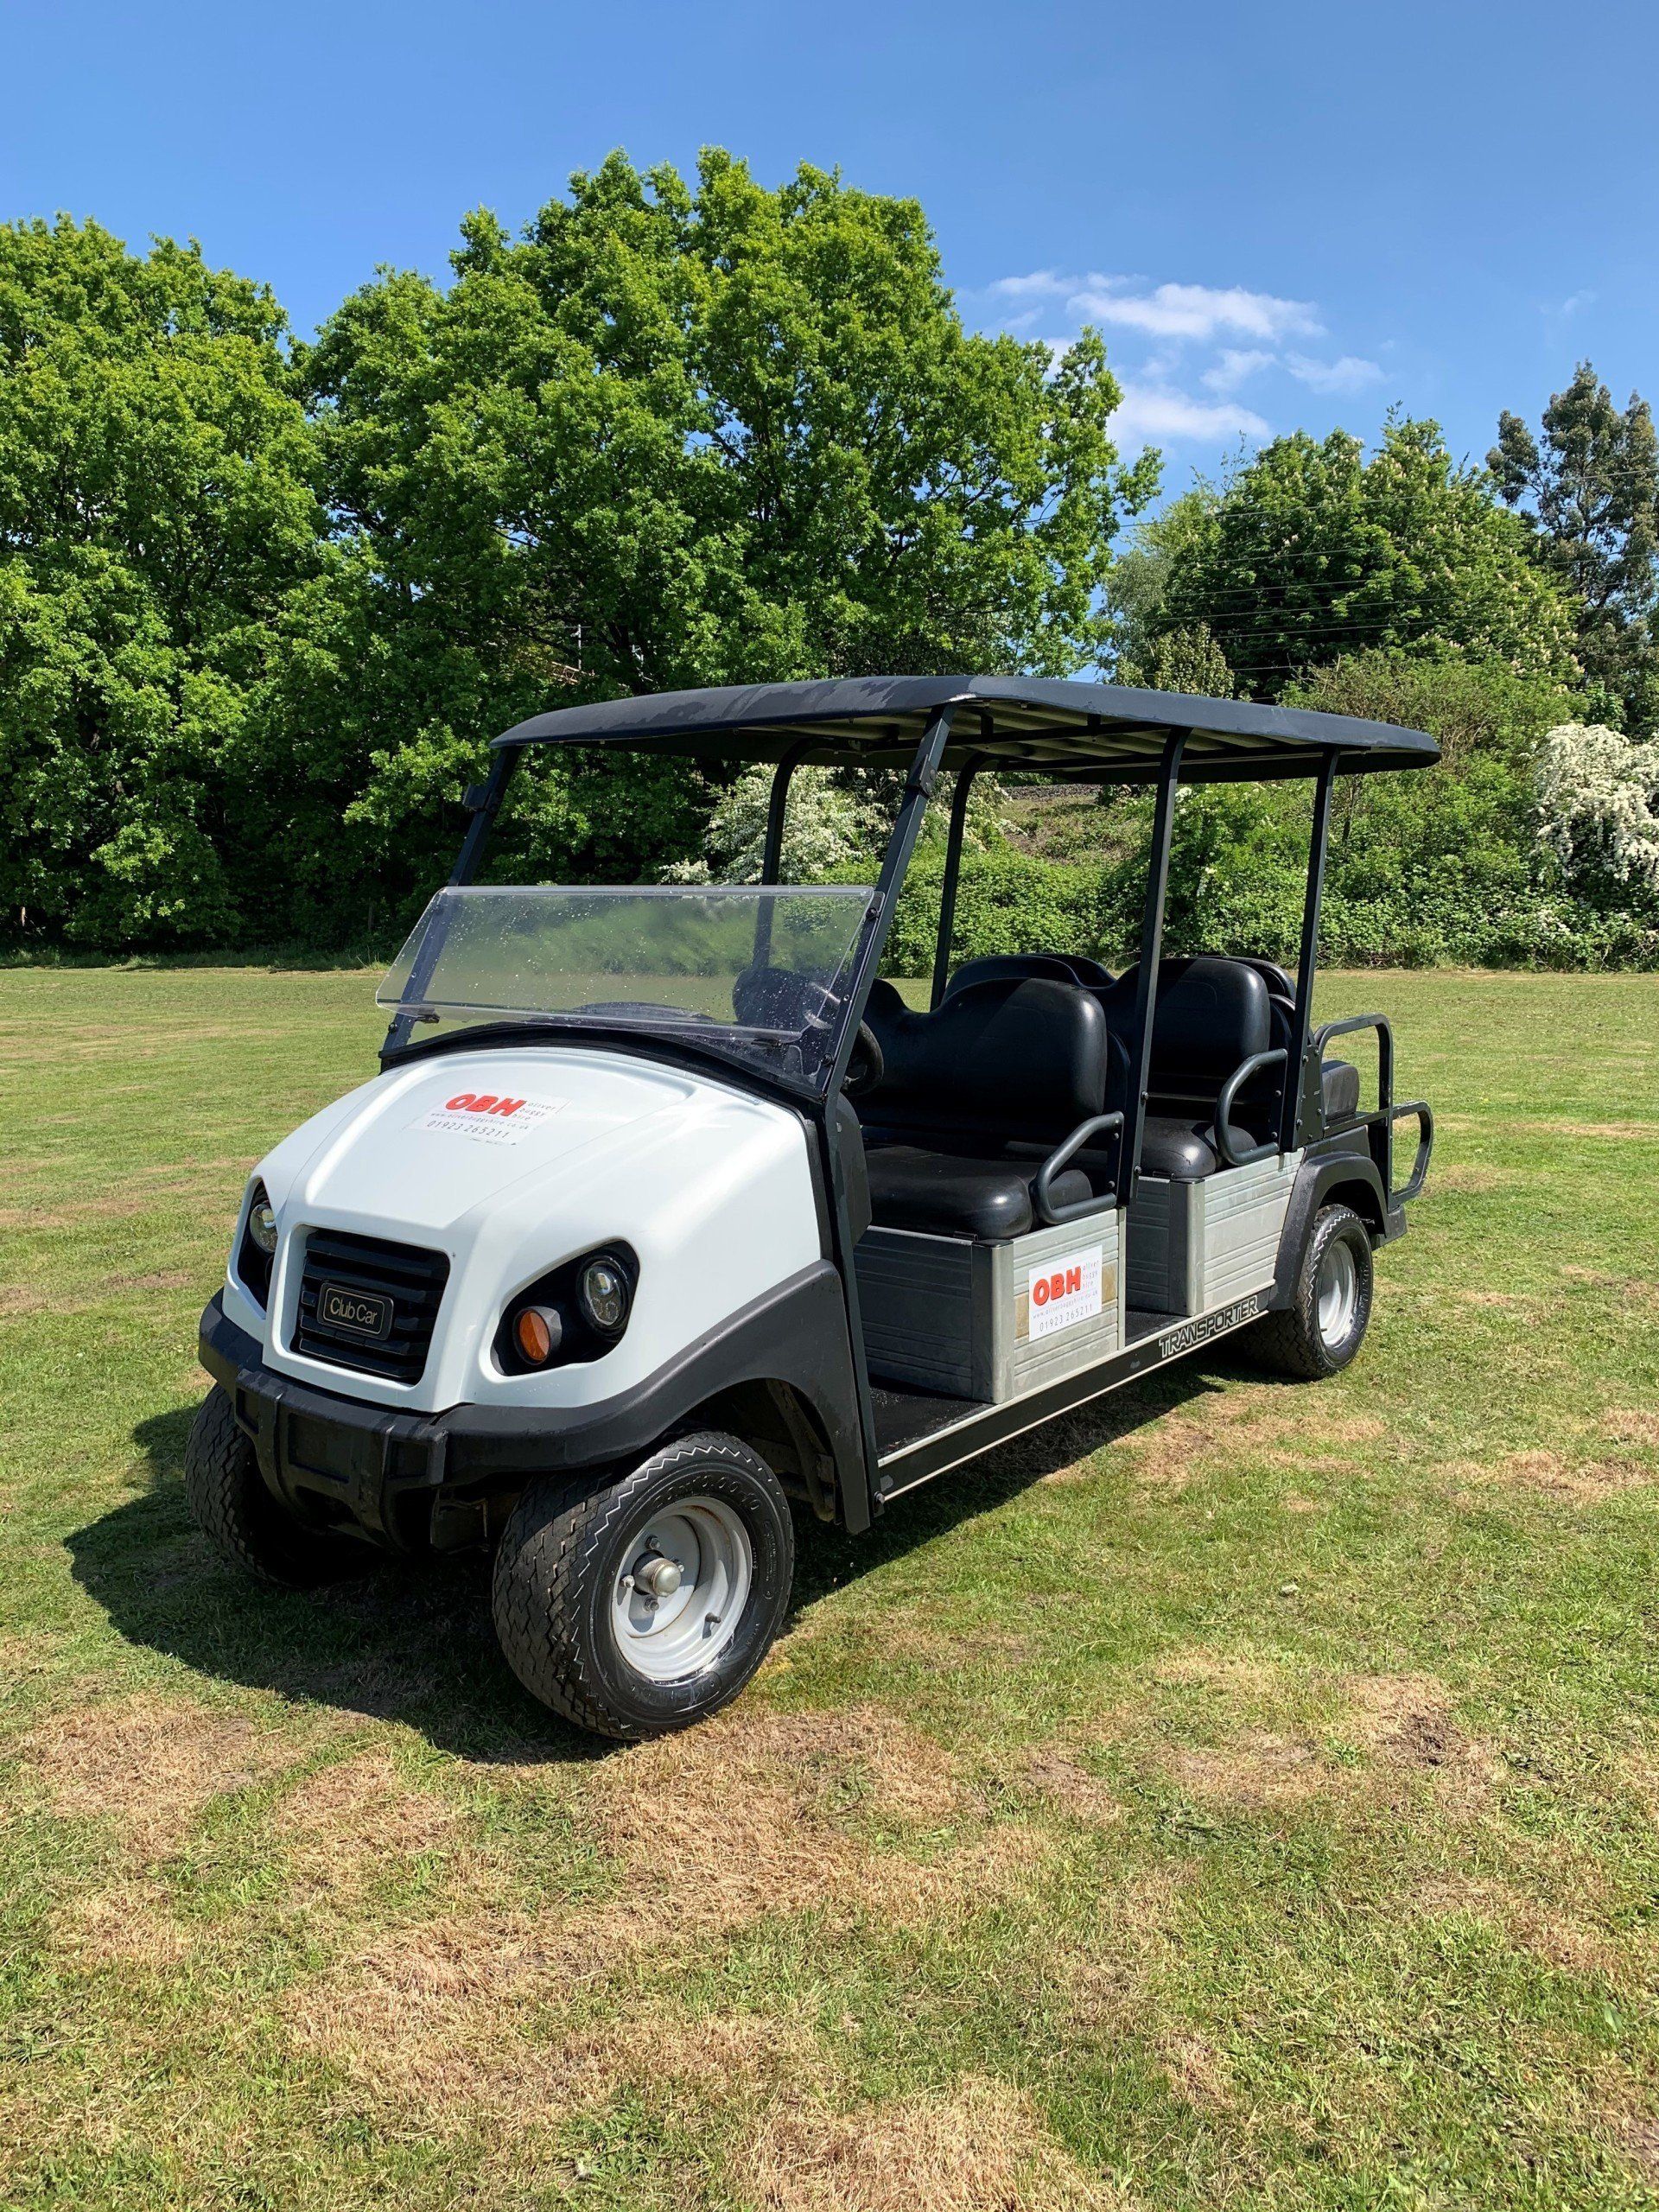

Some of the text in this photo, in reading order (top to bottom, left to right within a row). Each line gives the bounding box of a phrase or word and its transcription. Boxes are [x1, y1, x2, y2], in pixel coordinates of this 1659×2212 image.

[445, 1093, 528, 1117] OBH
[427, 1120, 512, 1139] 01923 265211
[1033, 1266, 1082, 1306] OBH
[330, 1297, 378, 1325] Club Car
[1039, 1303, 1092, 1332] 01923 265211
[1158, 1294, 1259, 1358] TRANSPORTER
